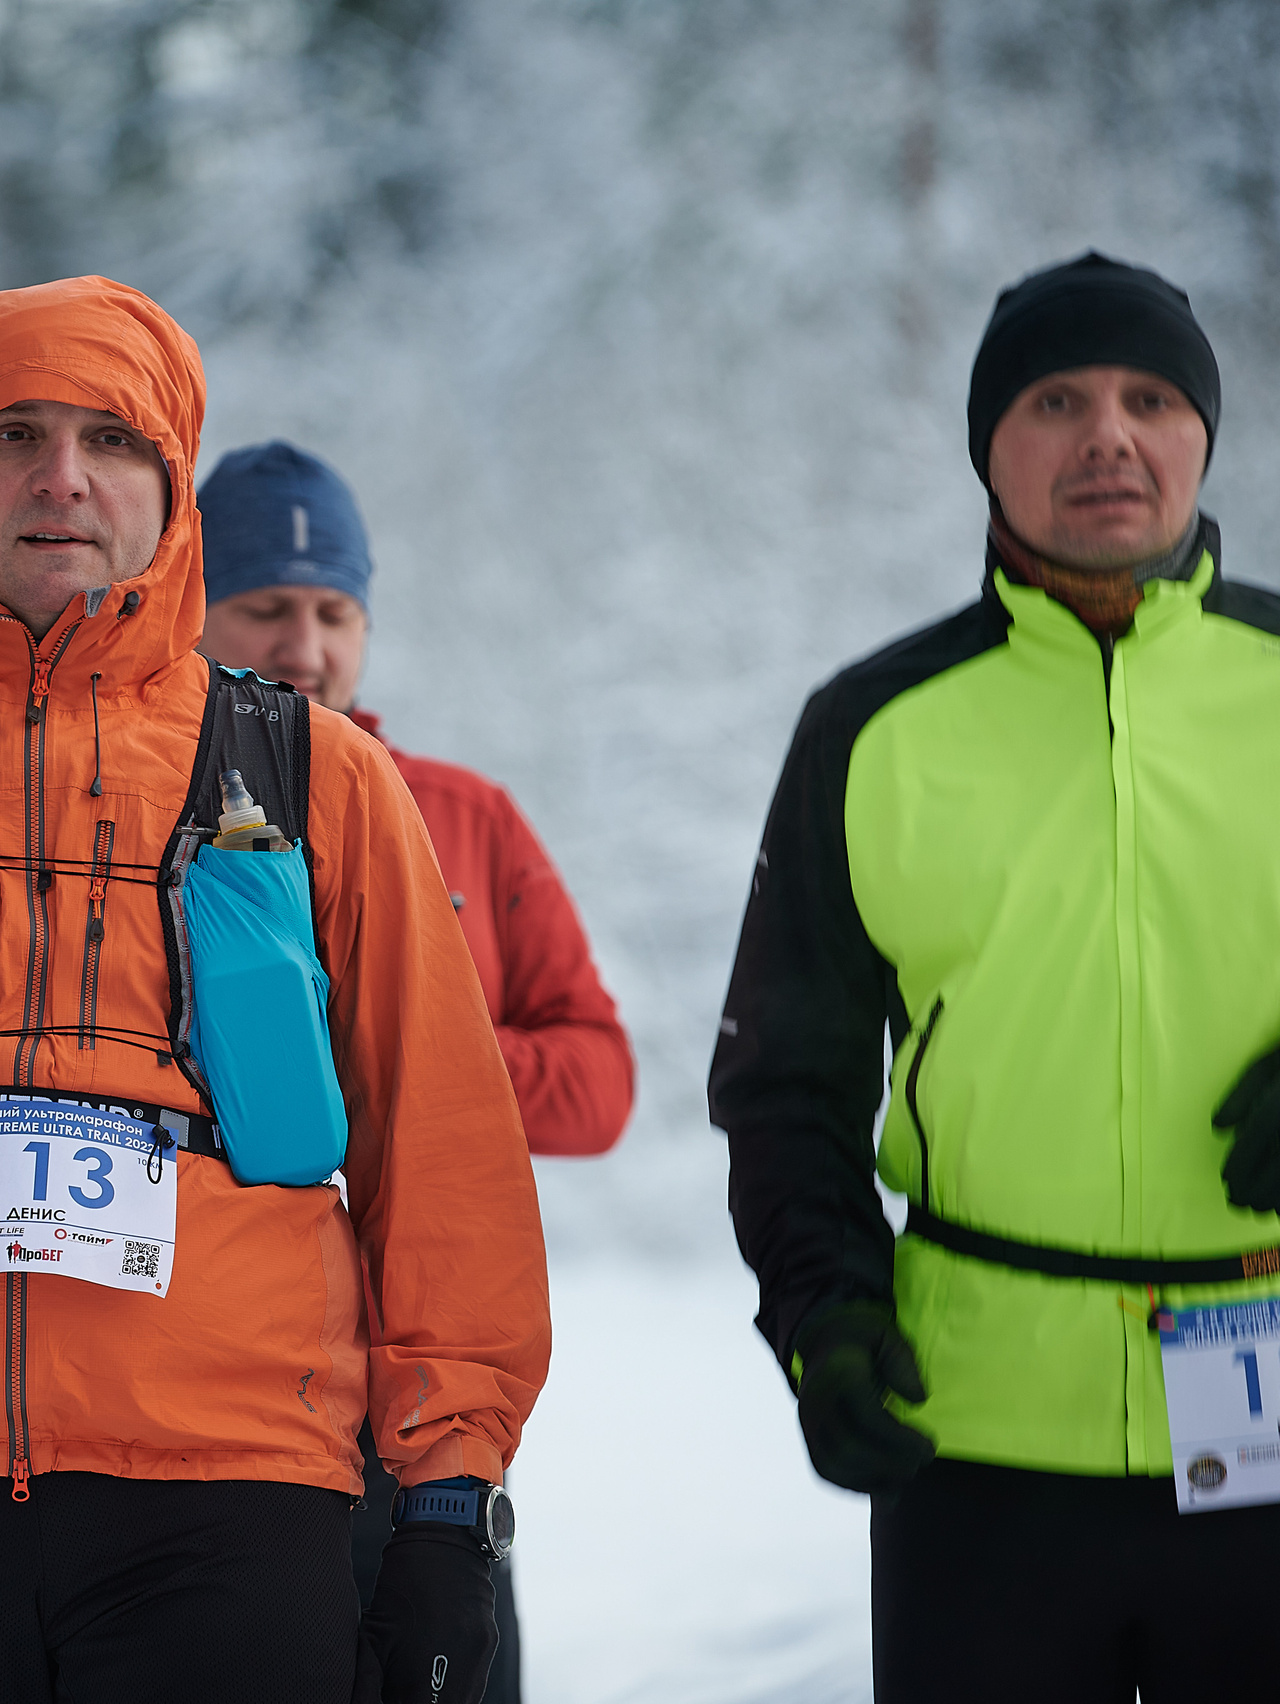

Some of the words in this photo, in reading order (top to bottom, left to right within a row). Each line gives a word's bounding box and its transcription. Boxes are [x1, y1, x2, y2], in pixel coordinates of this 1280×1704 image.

[23, 1108, 143, 1137] ультрамарафон
[43, 1122, 84, 1137] ULTRA
[86, 1128, 122, 1145] TRAIL
[6, 1207, 67, 1222] ДЕНИС
